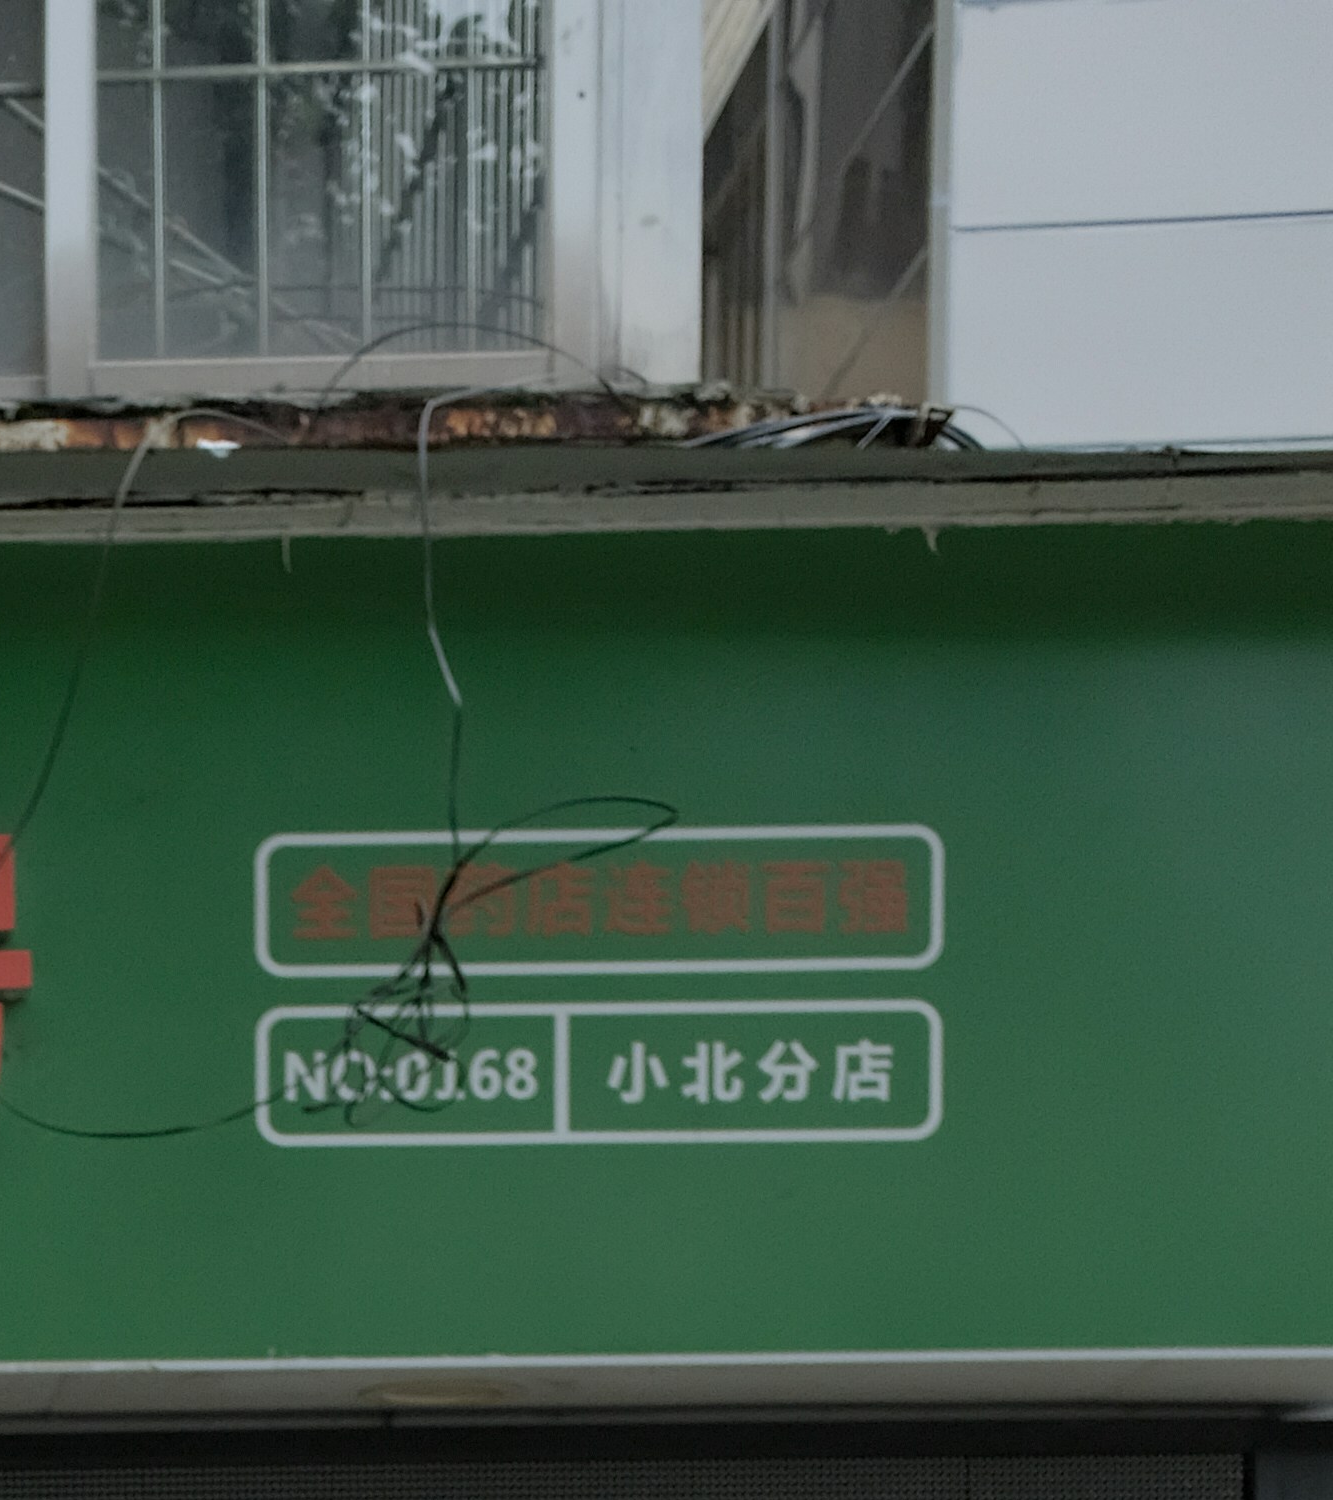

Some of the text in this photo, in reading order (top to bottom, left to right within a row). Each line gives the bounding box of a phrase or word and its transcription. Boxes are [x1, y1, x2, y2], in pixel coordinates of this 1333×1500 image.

[291, 860, 910, 941] 全国药店连锁百强
[607, 1038, 896, 1104] 小北分店
